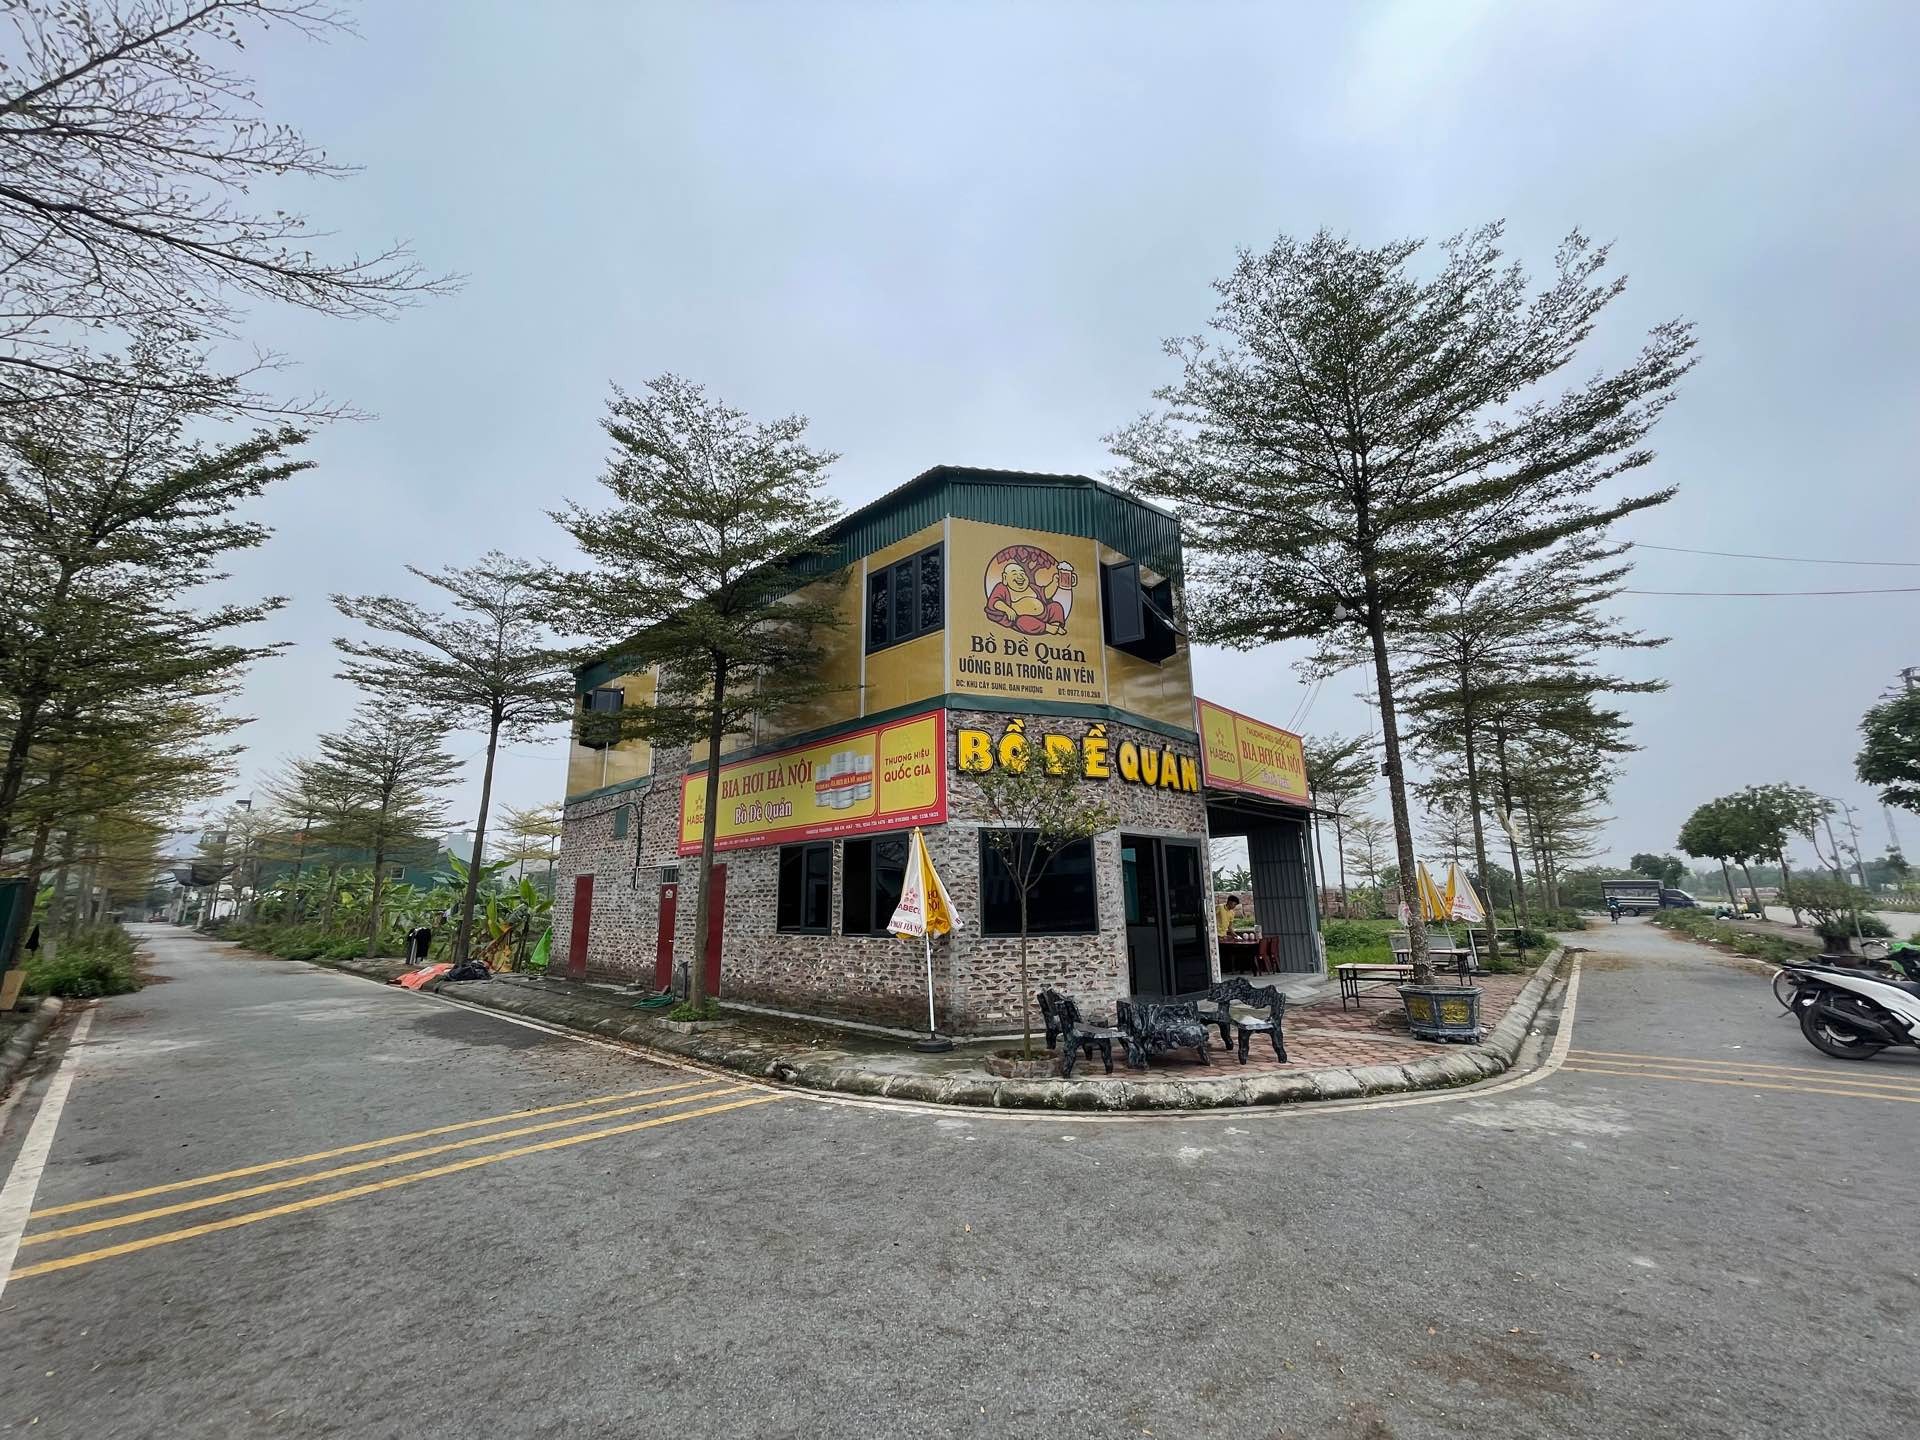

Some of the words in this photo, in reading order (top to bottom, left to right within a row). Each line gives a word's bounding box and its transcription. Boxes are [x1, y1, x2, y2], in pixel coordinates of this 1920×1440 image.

[971, 633, 997, 654] Bồ
[1004, 637, 1029, 656] Đề
[1035, 643, 1086, 664] Quán
[959, 655, 991, 675] UỐNG
[994, 663, 1014, 677] BIA
[1016, 663, 1053, 680] TRONG
[1055, 667, 1073, 682] AN
[1074, 666, 1095, 684] YÊN
[1209, 747, 1235, 764] HABECO
[1241, 740, 1258, 762] BIA
[721, 778, 740, 800] BIA
[742, 771, 764, 796] HƠI
[767, 763, 785, 790] HÀ
[788, 759, 813, 790] NỘI
[884, 763, 912, 783] QUỐC
[913, 764, 931, 777] GIA
[1117, 741, 1198, 793] QUÁN
